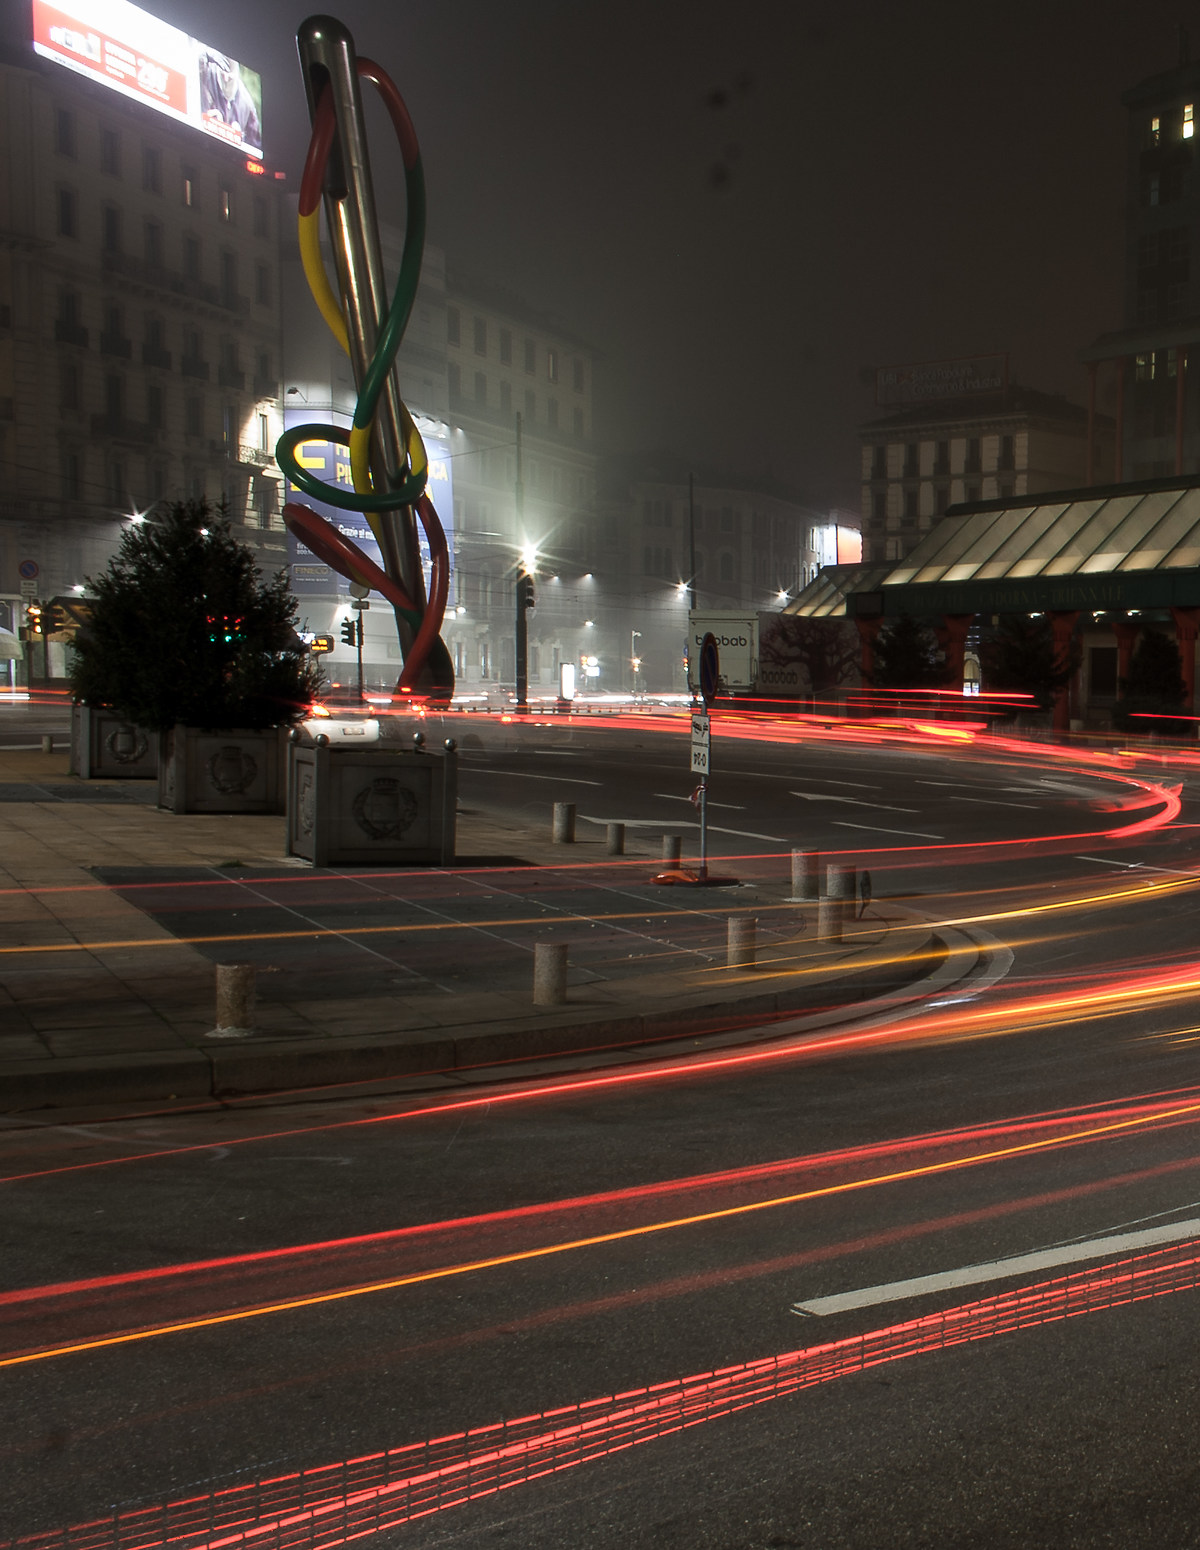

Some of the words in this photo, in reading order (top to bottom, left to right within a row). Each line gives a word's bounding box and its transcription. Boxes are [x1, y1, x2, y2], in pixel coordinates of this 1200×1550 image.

[1051, 585, 1126, 604] TRIENNALE
[695, 634, 747, 647] bobab
[761, 668, 798, 685] baobab
